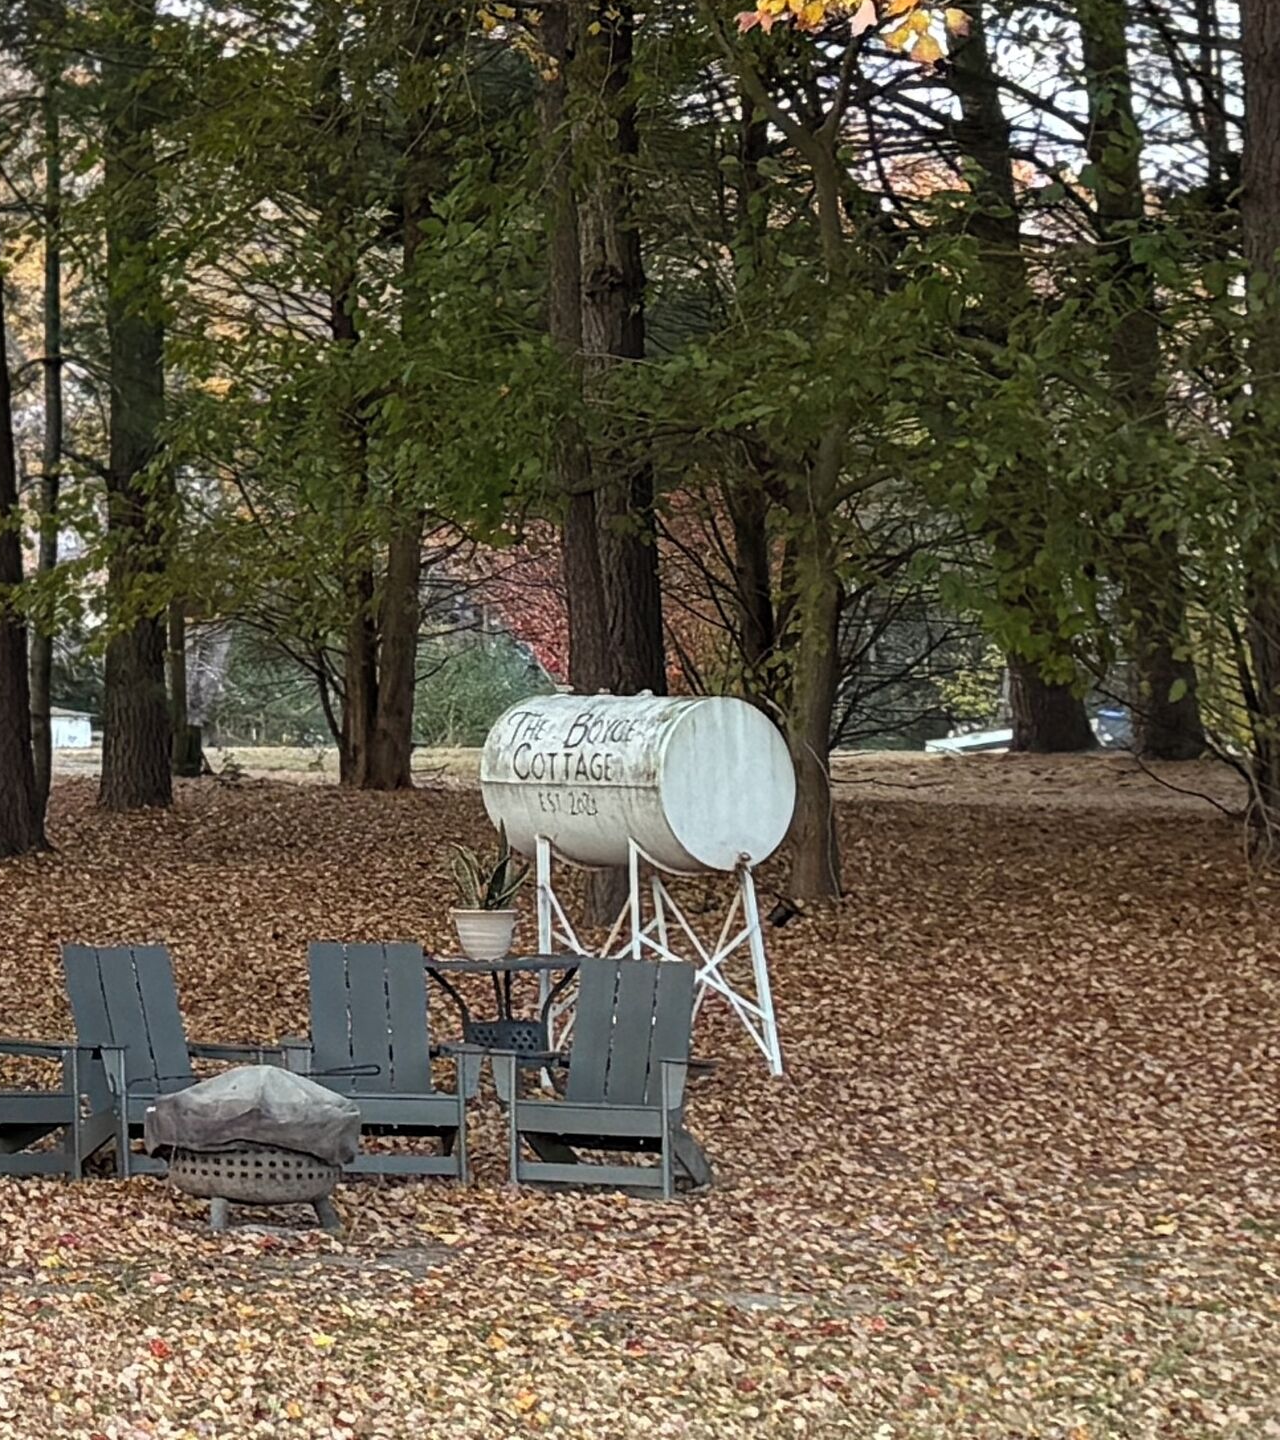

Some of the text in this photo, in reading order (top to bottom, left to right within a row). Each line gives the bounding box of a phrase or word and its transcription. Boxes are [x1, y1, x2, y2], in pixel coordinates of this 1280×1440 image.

[508, 711, 638, 748] THE BOYCE
[513, 742, 613, 781] COTTAGE
